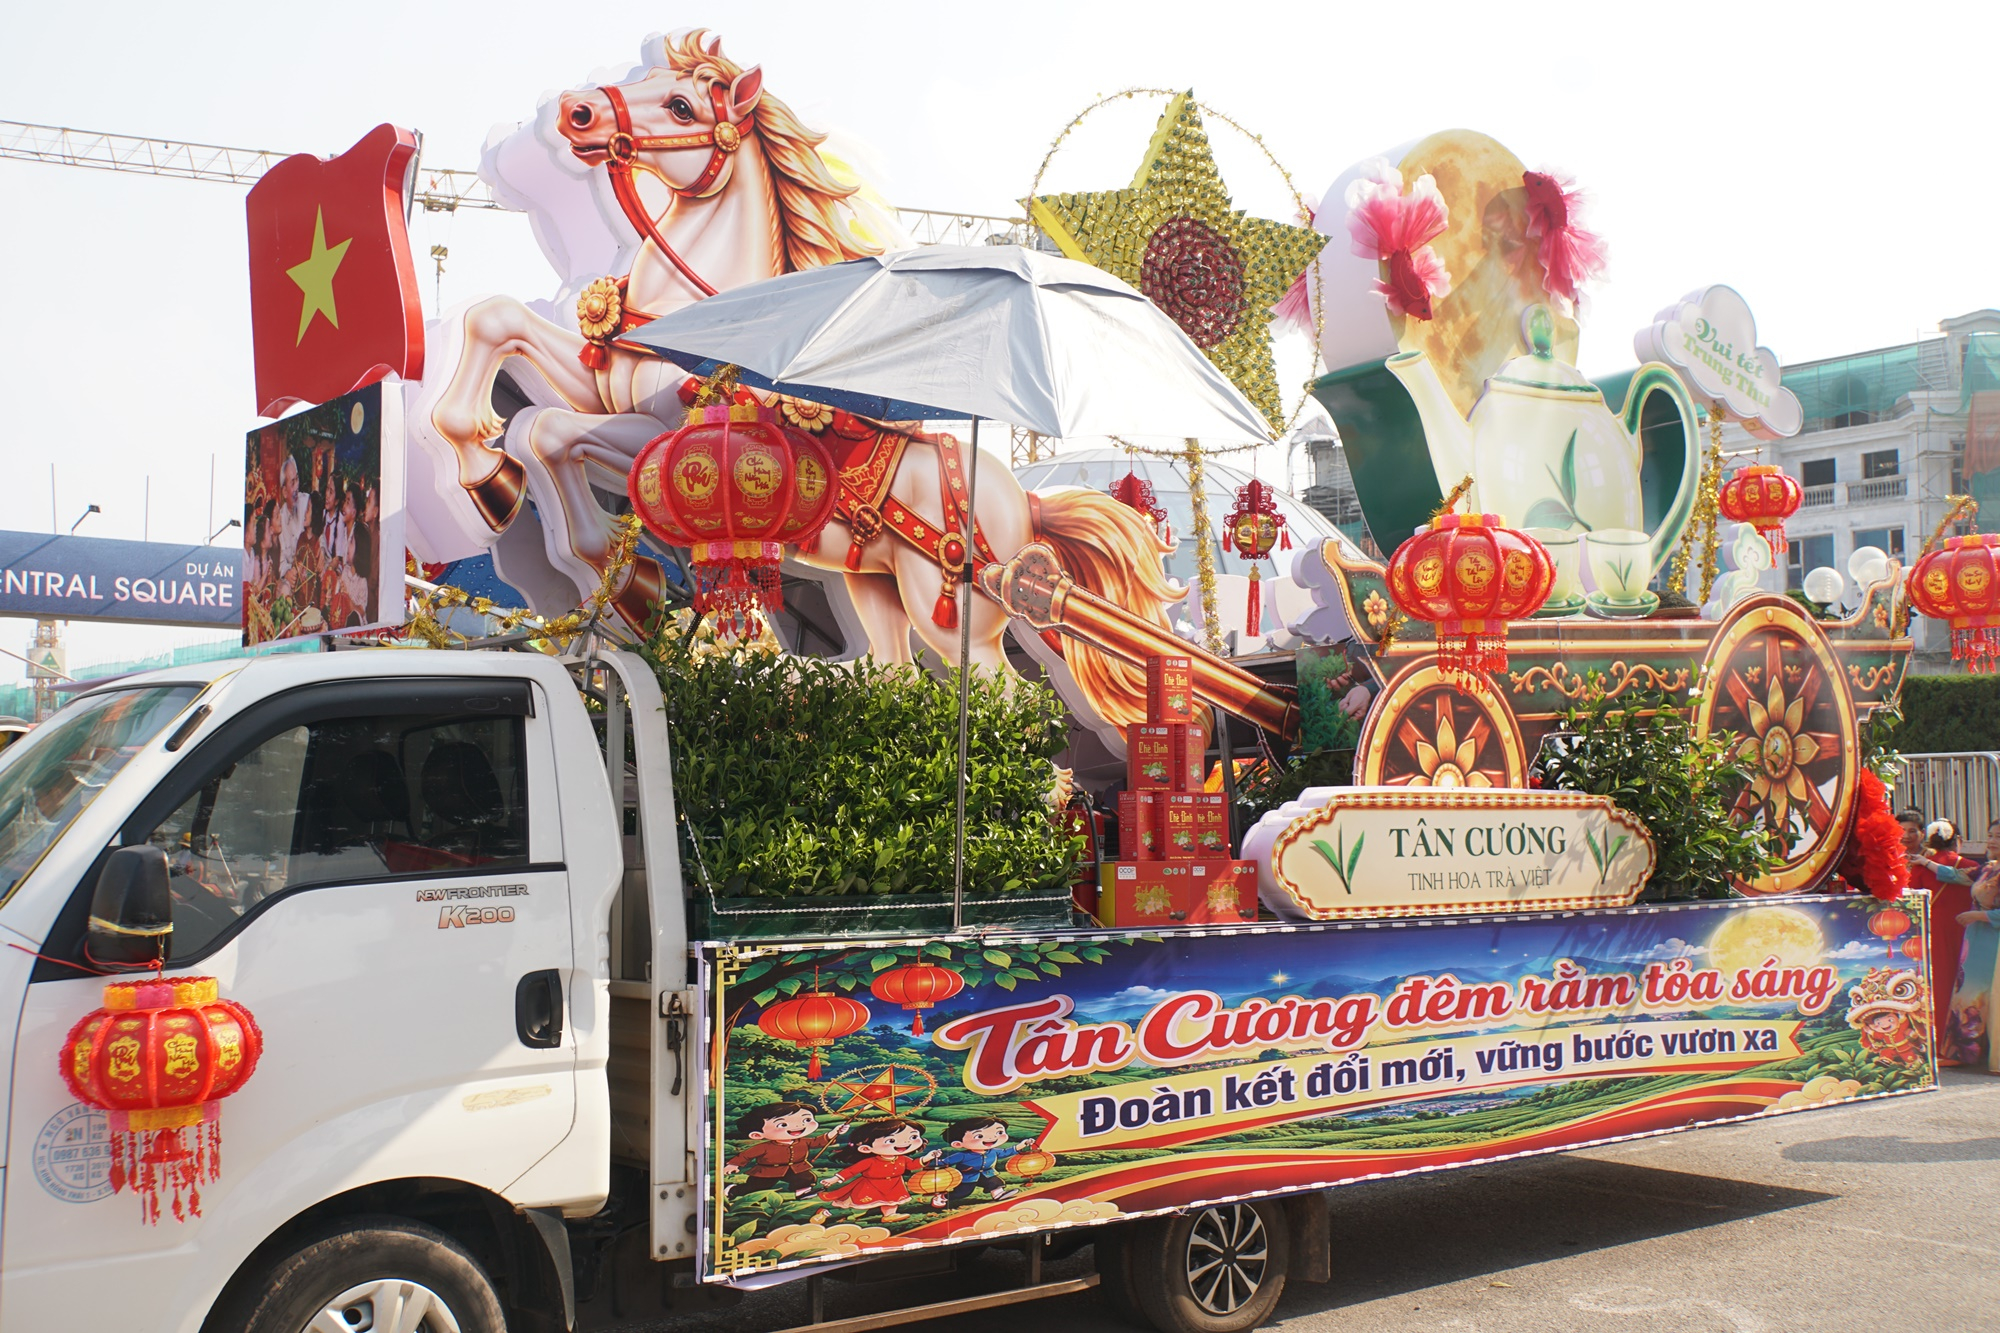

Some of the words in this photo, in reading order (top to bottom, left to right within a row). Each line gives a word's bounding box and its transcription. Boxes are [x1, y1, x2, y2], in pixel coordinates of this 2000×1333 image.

[1695, 318, 1733, 361] Vui
[1737, 353, 1764, 379] tết
[1683, 332, 1734, 386] Trung
[1735, 372, 1771, 408] Thu
[0, 569, 104, 600] NTRAL
[114, 576, 233, 607] SQUARE
[186, 562, 209, 579] DỰ
[212, 562, 234, 578] ÁN
[1388, 817, 1456, 858] TÂN
[1464, 822, 1567, 858] CƯƠNG
[1407, 872, 1444, 892] TINH
[1448, 869, 1482, 890] HOA
[1486, 866, 1516, 888] TRÀ
[1520, 865, 1553, 888] VIỆT
[438, 905, 515, 929] K200
[943, 995, 1136, 1089] Tân
[1141, 992, 1378, 1050] Cương
[1385, 973, 1513, 1027] đêm
[1519, 959, 1637, 1012] rằm
[1641, 957, 1724, 1001] tỏa
[1727, 955, 1836, 1014] sáng
[1080, 1084, 1217, 1137] Đoàn
[1224, 1066, 1296, 1113] kết
[1306, 1052, 1369, 1099] đổi
[1381, 1045, 1466, 1088] mới,
[1475, 1032, 1564, 1076] vững
[1572, 1027, 1654, 1065] bước
[1664, 1026, 1736, 1056] vươn
[1743, 1028, 1778, 1052] xa
